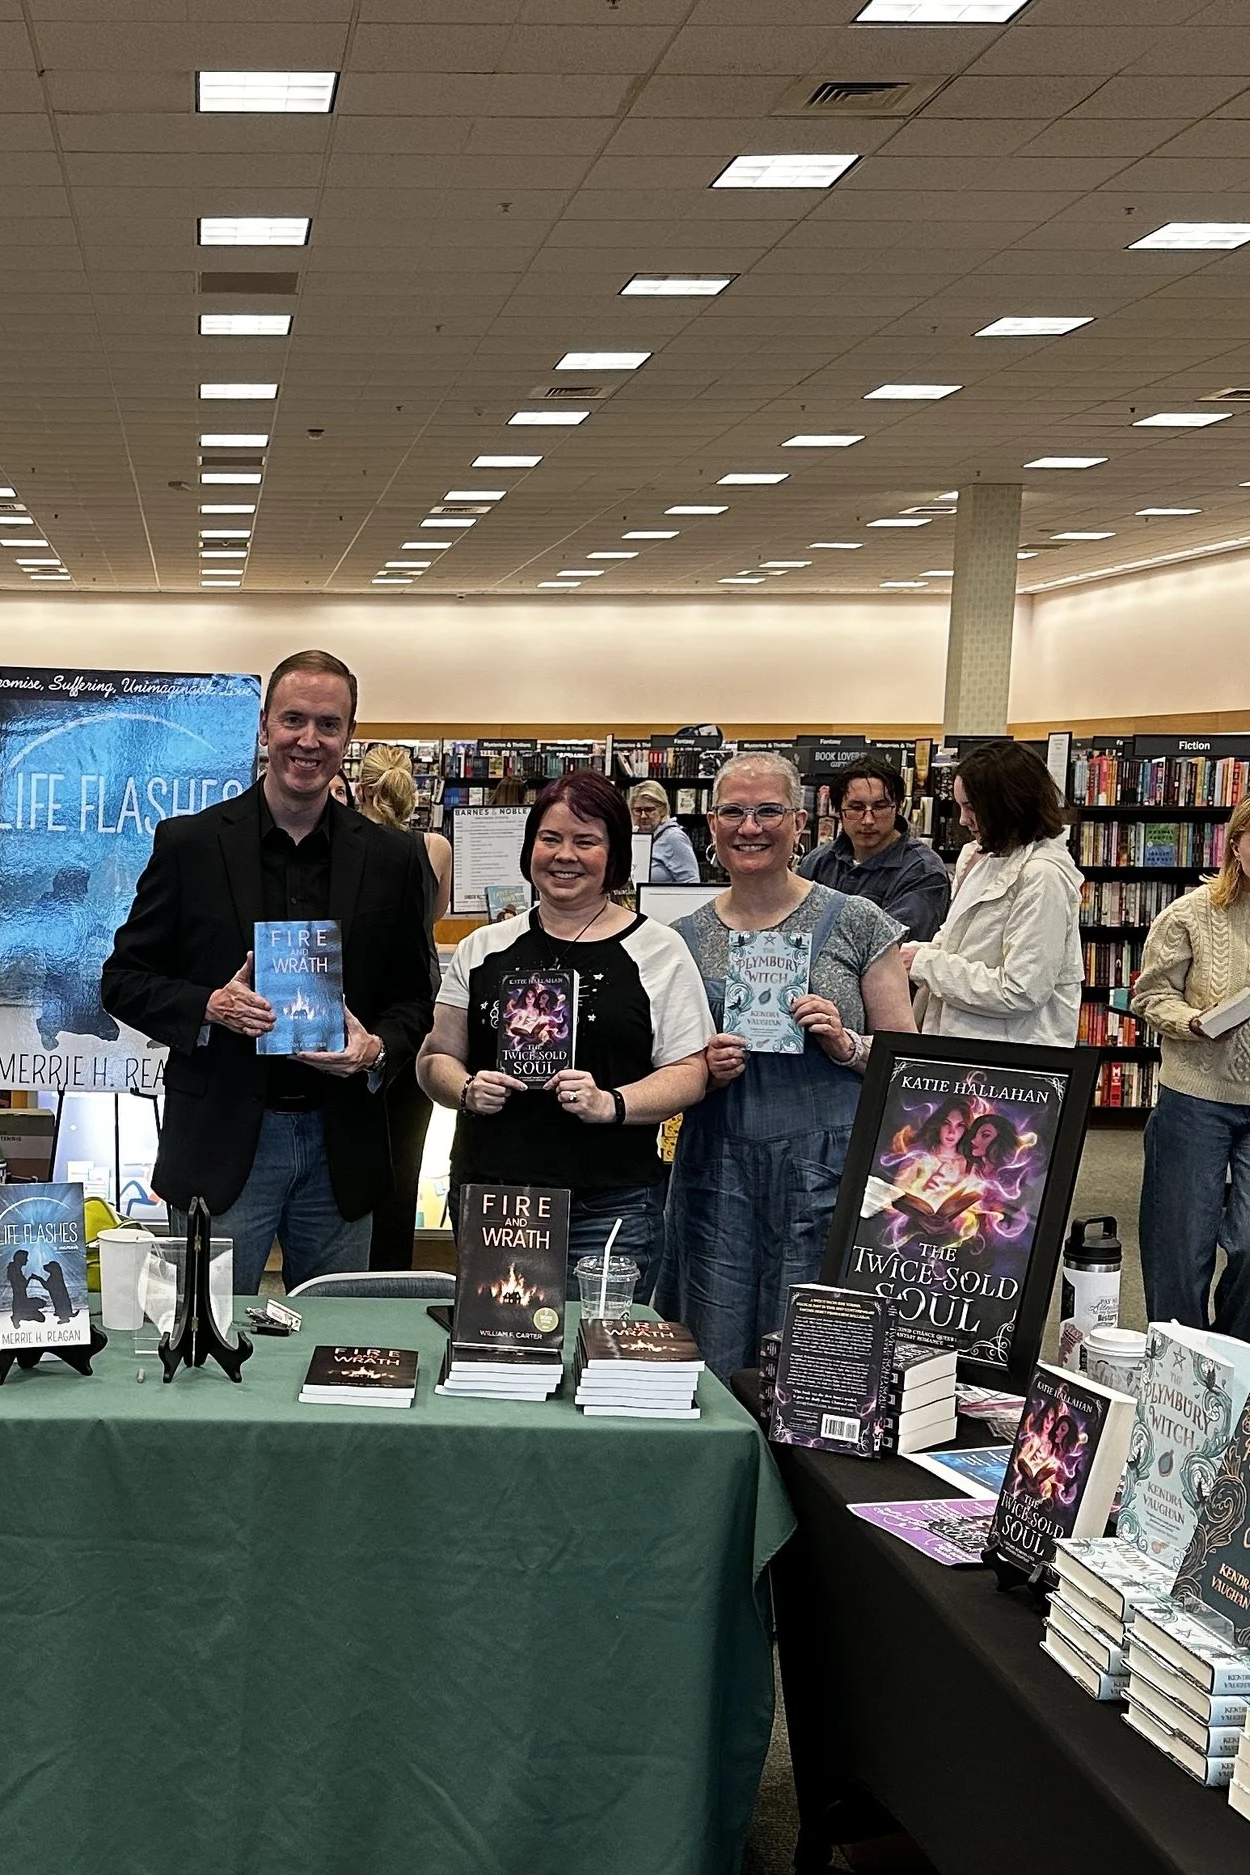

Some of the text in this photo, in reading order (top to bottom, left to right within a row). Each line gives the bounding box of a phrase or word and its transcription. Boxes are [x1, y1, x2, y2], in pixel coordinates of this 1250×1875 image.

[49, 675, 117, 698] Suffering,
[674, 738, 695, 746] Fantasy
[1178, 741, 1211, 750] Fiction
[814, 752, 836, 761] BOOK
[455, 808, 490, 816] BARNES
[499, 807, 528, 815] NOBLE
[270, 929, 328, 947] FIRE
[290, 949, 309, 957] AND
[272, 957, 328, 974] WRATH
[736, 955, 801, 974] PLYMBURY
[745, 970, 788, 984] WITCH
[93, 1057, 116, 1088] H.
[125, 1057, 166, 1088] REA
[513, 1061, 556, 1075] SOUL
[901, 1075, 1050, 1104] KATIE HALLAHAN
[482, 1193, 552, 1218] FIRE
[504, 1218, 528, 1227] AND
[22, 1222, 78, 1244] FLASHES
[482, 1227, 550, 1250] WRATH
[918, 1243, 958, 1263] THE
[852, 1245, 1019, 1301] TWICE-SOLD
[876, 1281, 981, 1334] SOUL
[601, 1320, 672, 1330] FIRE
[604, 1328, 674, 1338] WRATH
[2, 1332, 33, 1345] MERRIE
[46, 1328, 81, 1343] REAGAN
[479, 1329, 509, 1338] WILLIAM
[515, 1331, 543, 1340] CARTER
[334, 1348, 401, 1358] FIRE
[334, 1356, 400, 1366] WRATH
[1170, 1372, 1182, 1386] THE
[1036, 1380, 1093, 1413] KATIE HALLAHAN
[1144, 1384, 1211, 1435] PLYMBURY
[1149, 1405, 1195, 1449] WITCH
[1024, 1495, 1039, 1510] THE
[1147, 1482, 1183, 1509] KENDRA
[1000, 1490, 1064, 1539] TWICE-SOLD
[1143, 1496, 1185, 1525] VAUGHAN
[1001, 1515, 1045, 1556] SOUL
